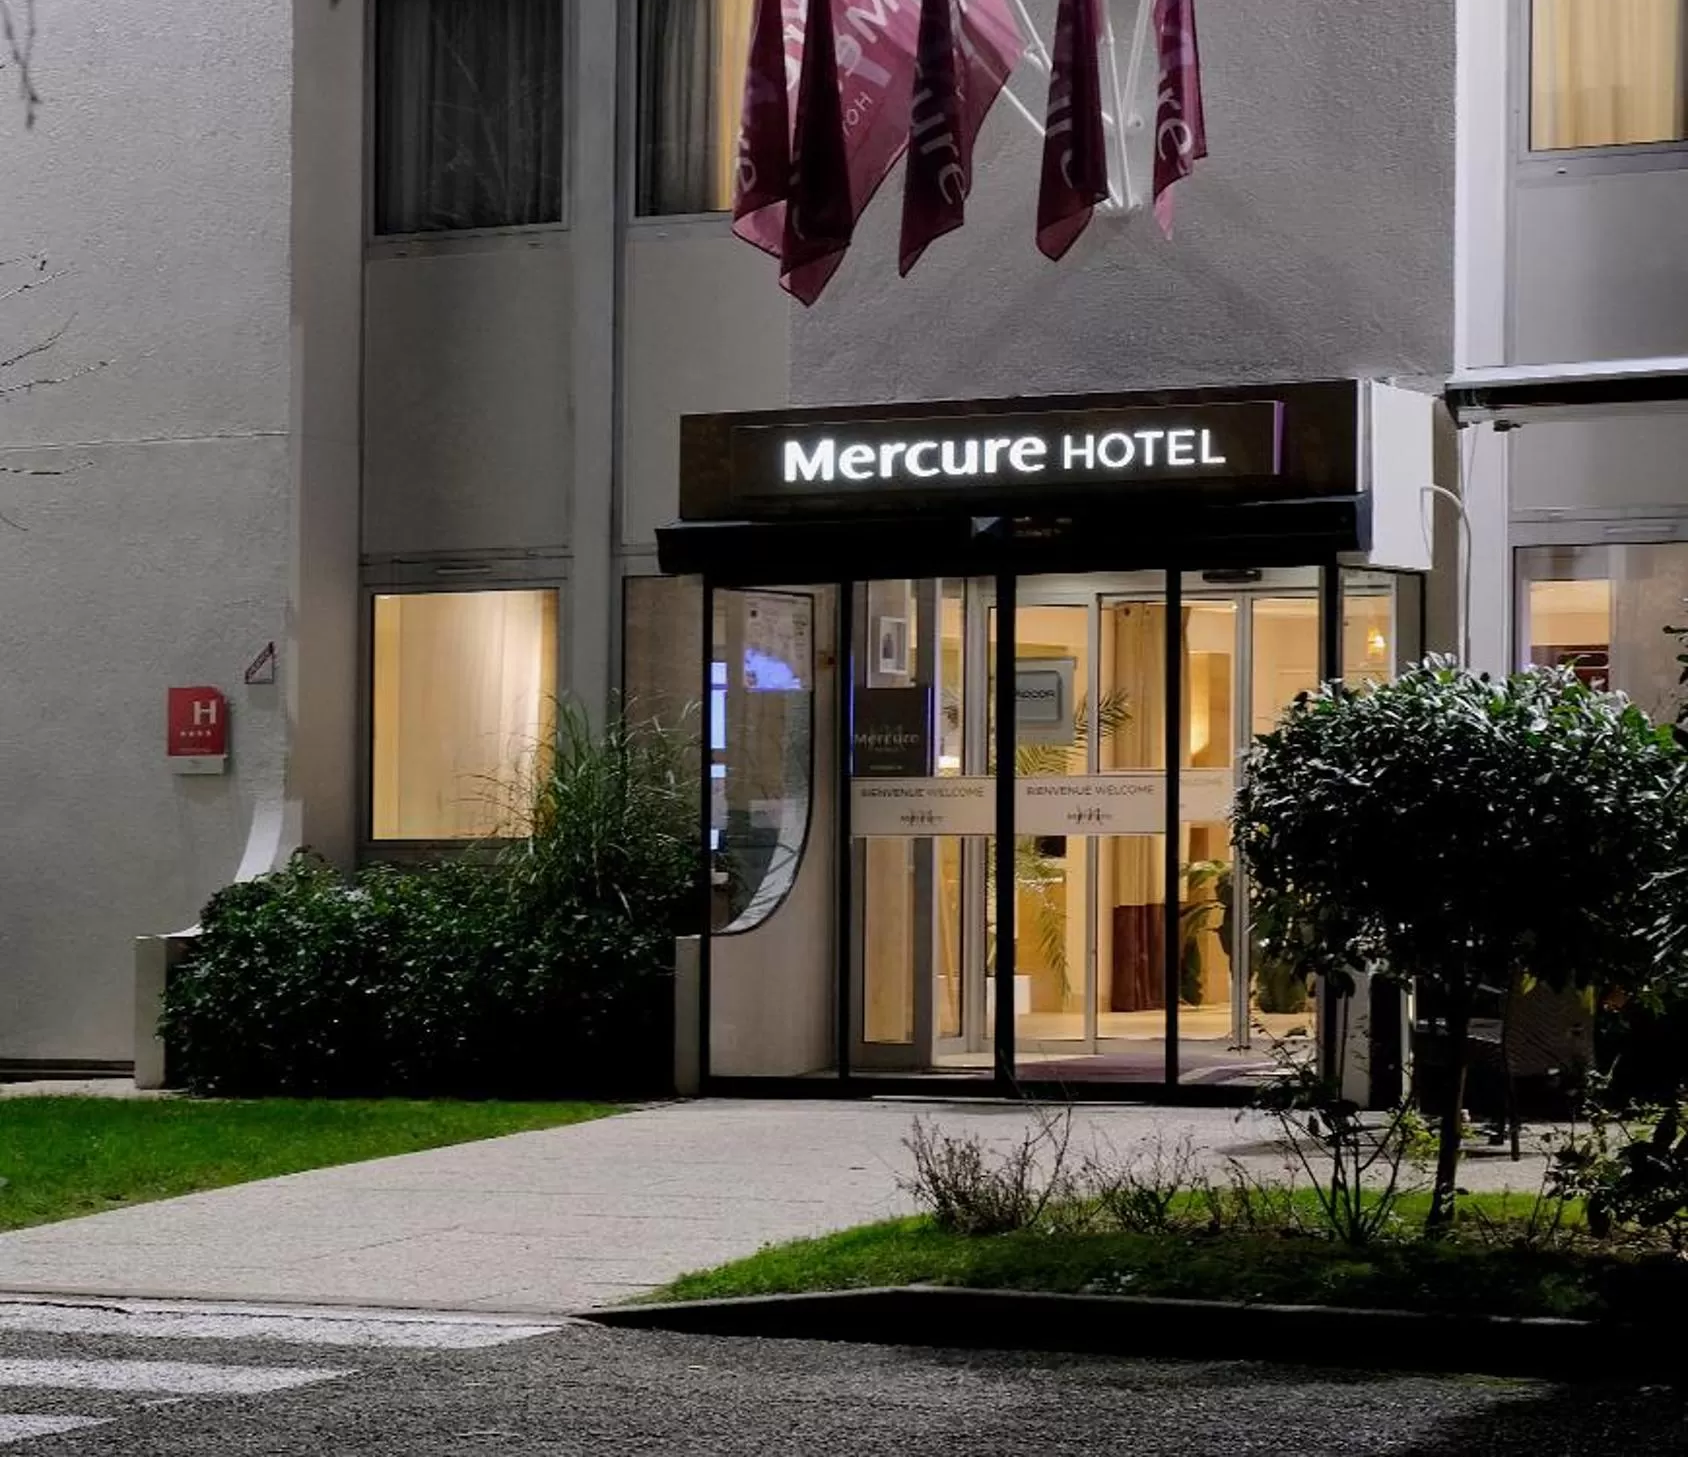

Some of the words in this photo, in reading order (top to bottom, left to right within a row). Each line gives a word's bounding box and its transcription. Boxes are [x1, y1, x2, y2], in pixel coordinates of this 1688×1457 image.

[783, 434, 1048, 482] Mercure
[1062, 428, 1226, 470] HOTEL
[193, 700, 217, 725] H
[861, 787, 925, 798] BIENVENUE
[927, 787, 985, 797] WELCOME
[1027, 785, 1092, 796] BIENVENUE
[1095, 784, 1155, 795] WELCOME
